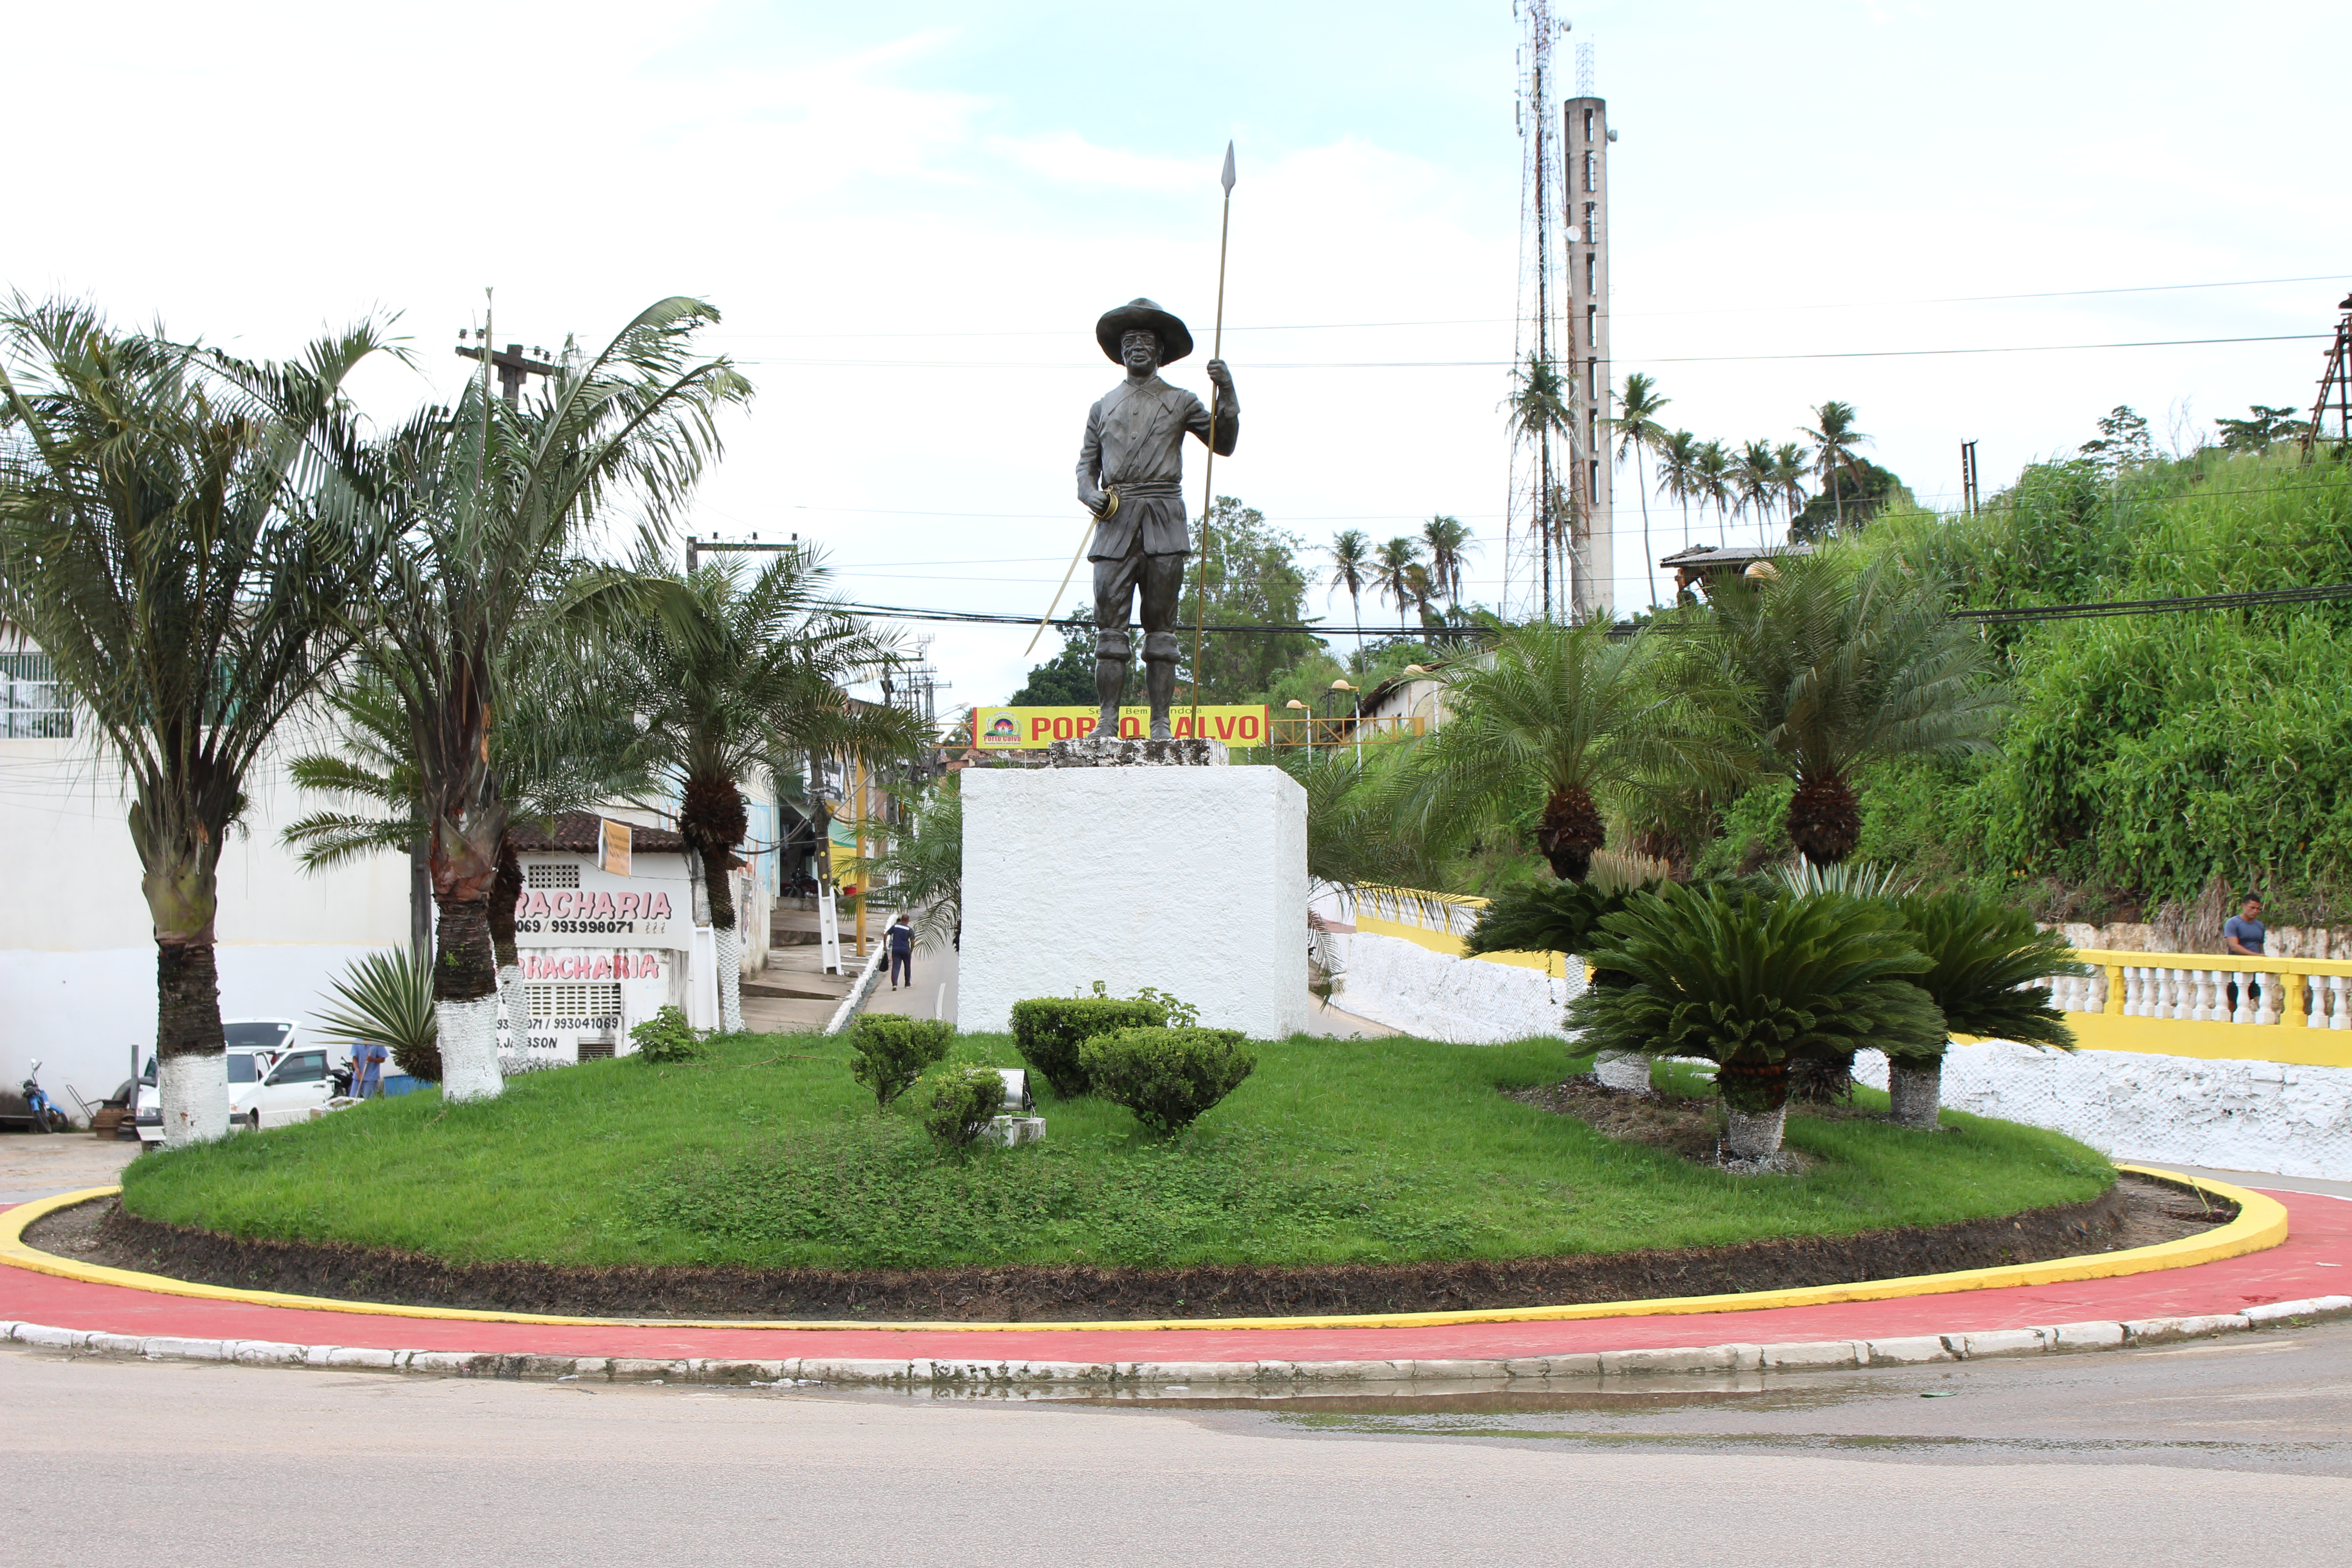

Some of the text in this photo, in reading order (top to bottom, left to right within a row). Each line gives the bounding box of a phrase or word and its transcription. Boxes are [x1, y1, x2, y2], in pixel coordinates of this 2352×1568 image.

[1032, 715, 1259, 741] PORO ALVO
[551, 921, 633, 934] 993998071
[554, 1017, 618, 1029] 993041069
